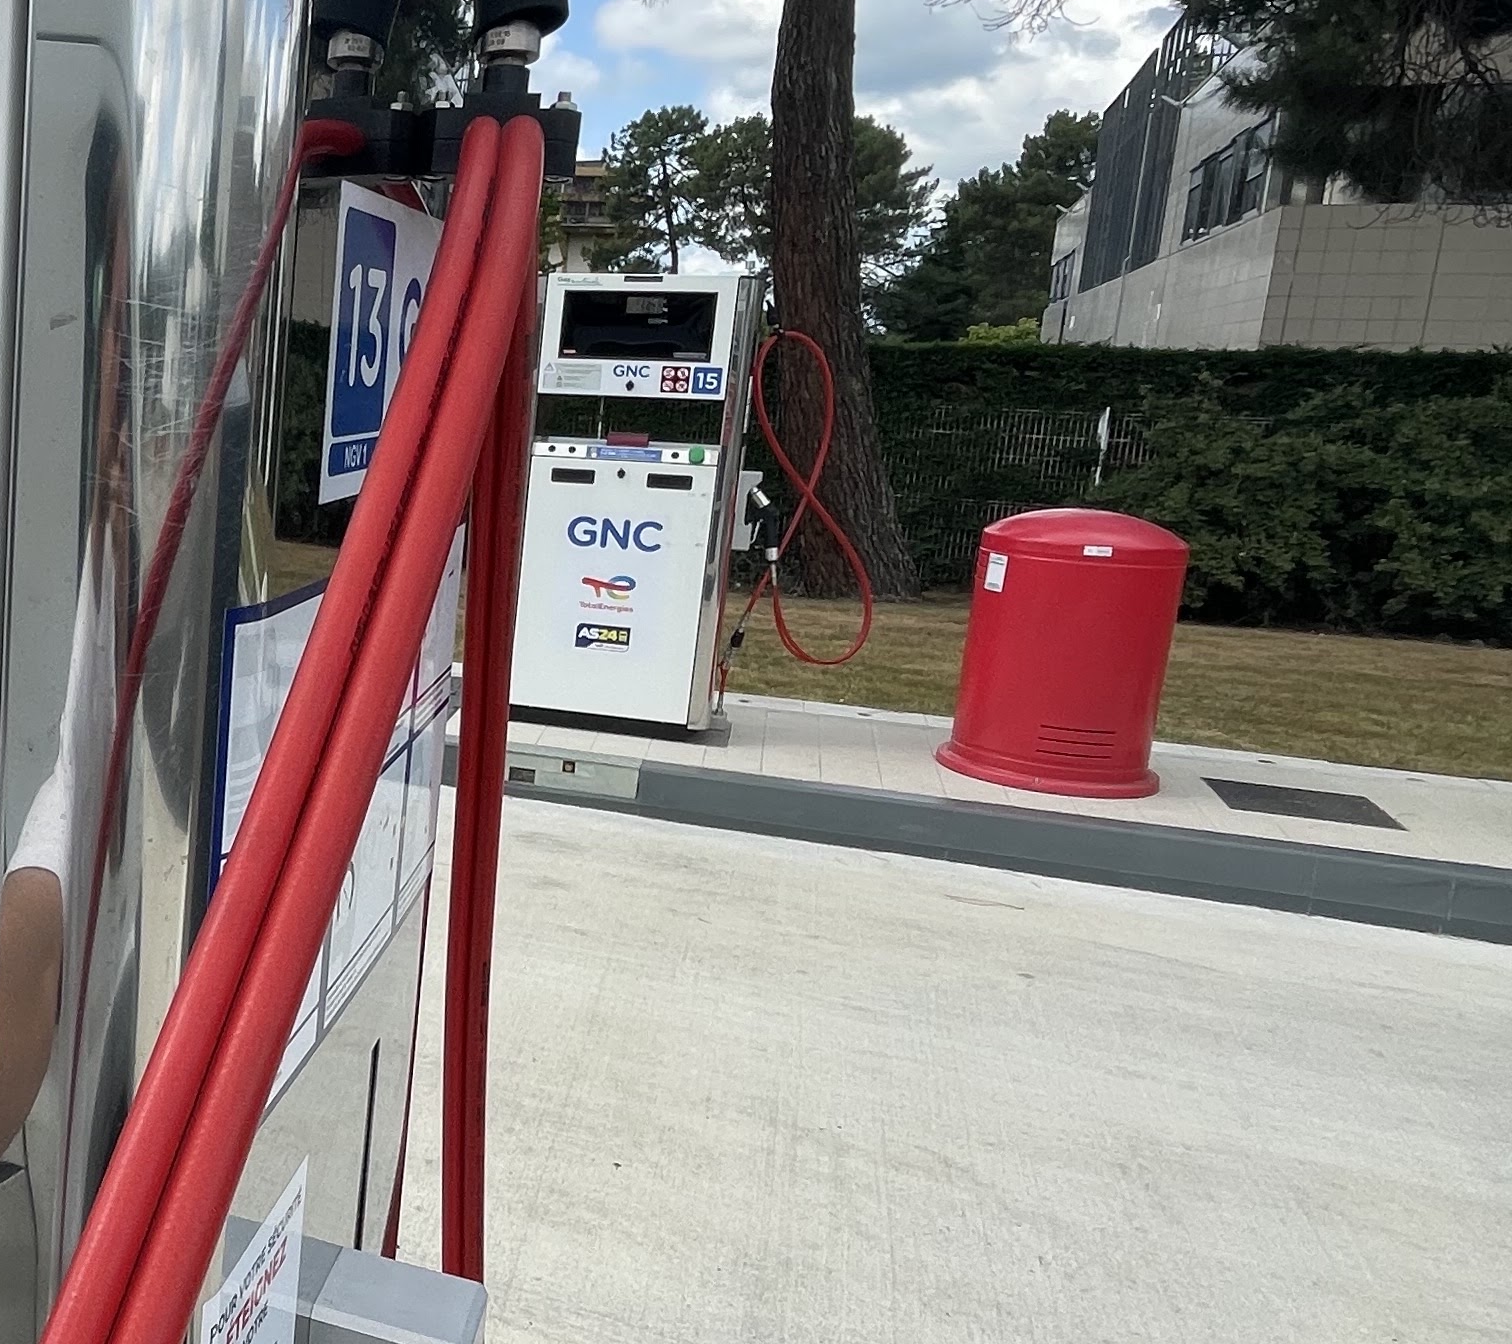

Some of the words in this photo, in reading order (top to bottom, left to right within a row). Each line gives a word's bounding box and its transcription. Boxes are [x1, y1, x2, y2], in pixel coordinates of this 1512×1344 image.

[348, 264, 387, 387] 13
[613, 364, 651, 379] GNC
[696, 372, 718, 390] 15
[567, 515, 664, 553] GNC
[578, 600, 634, 613] TotalEnergies
[577, 626, 618, 641] AS24
[239, 1243, 267, 1300] VOTRE
